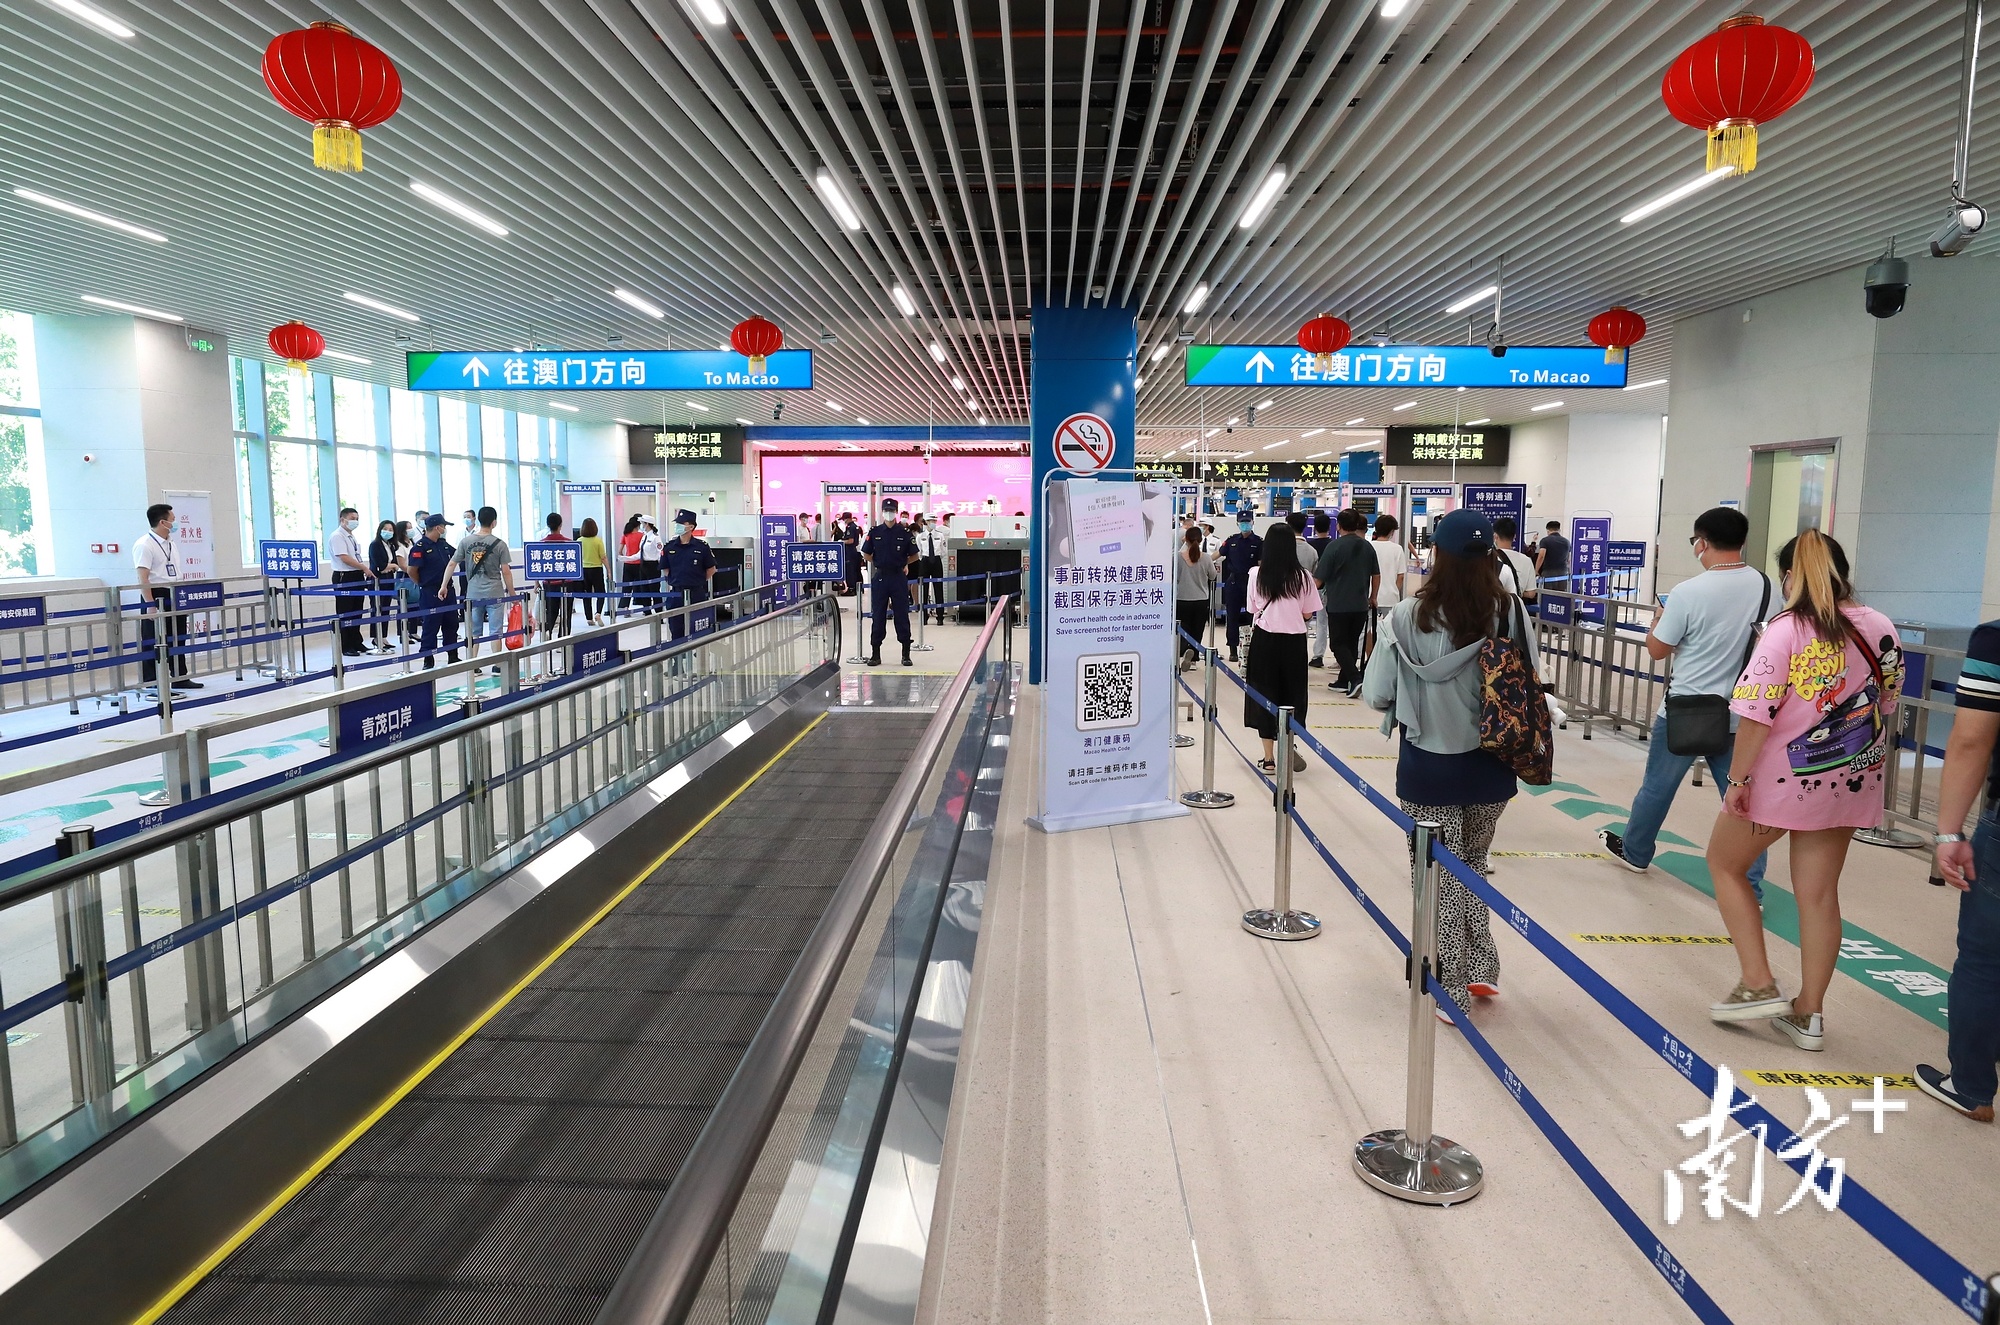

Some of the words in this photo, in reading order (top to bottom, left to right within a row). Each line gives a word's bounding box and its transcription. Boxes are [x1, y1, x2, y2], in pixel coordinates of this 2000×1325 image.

[503, 358, 646, 386] 往澳门方向
[1290, 353, 1447, 382] 往澳门方向
[704, 371, 722, 386] To
[727, 371, 779, 386] Macao
[1509, 368, 1529, 383] To
[1534, 368, 1590, 384] Macao
[654, 433, 722, 445] 请佩戴好口罩
[1412, 433, 1485, 446] 请佩戴好口罩
[654, 446, 722, 458] 保持安全距离
[1412, 447, 1485, 461] 保持安全距离
[1233, 464, 1269, 472] 卫生检疫
[1476, 492, 1513, 501] 特别通道
[266, 548, 312, 559] 请您在黄
[530, 549, 576, 561] 请您在黄
[792, 550, 838, 561] 请您在黄
[267, 560, 313, 571] 线内等候
[531, 561, 577, 573] 线内等候
[792, 562, 838, 573] 线内等候
[1054, 565, 1164, 585] 事前转换健康码
[1053, 588, 1164, 609] 截图保存通关快
[0, 607, 36, 619] 海安保集团
[1059, 616, 1086, 624] Convert
[1087, 614, 1107, 622] health
[1056, 627, 1072, 635] Save
[1074, 626, 1110, 634] screenshot
[1122, 624, 1140, 632] faster
[1142, 623, 1163, 631] border
[1097, 635, 1124, 643] crossing
[582, 648, 607, 668] 青茂口岸
[361, 705, 413, 741] 青茂口岸
[1083, 734, 1130, 747] 澳门健康码
[1068, 761, 1146, 777] 请扫描二维码作申报
[1663, 1033, 1693, 1070] 中国口岸
[1655, 1243, 1686, 1287] 中国口岸
